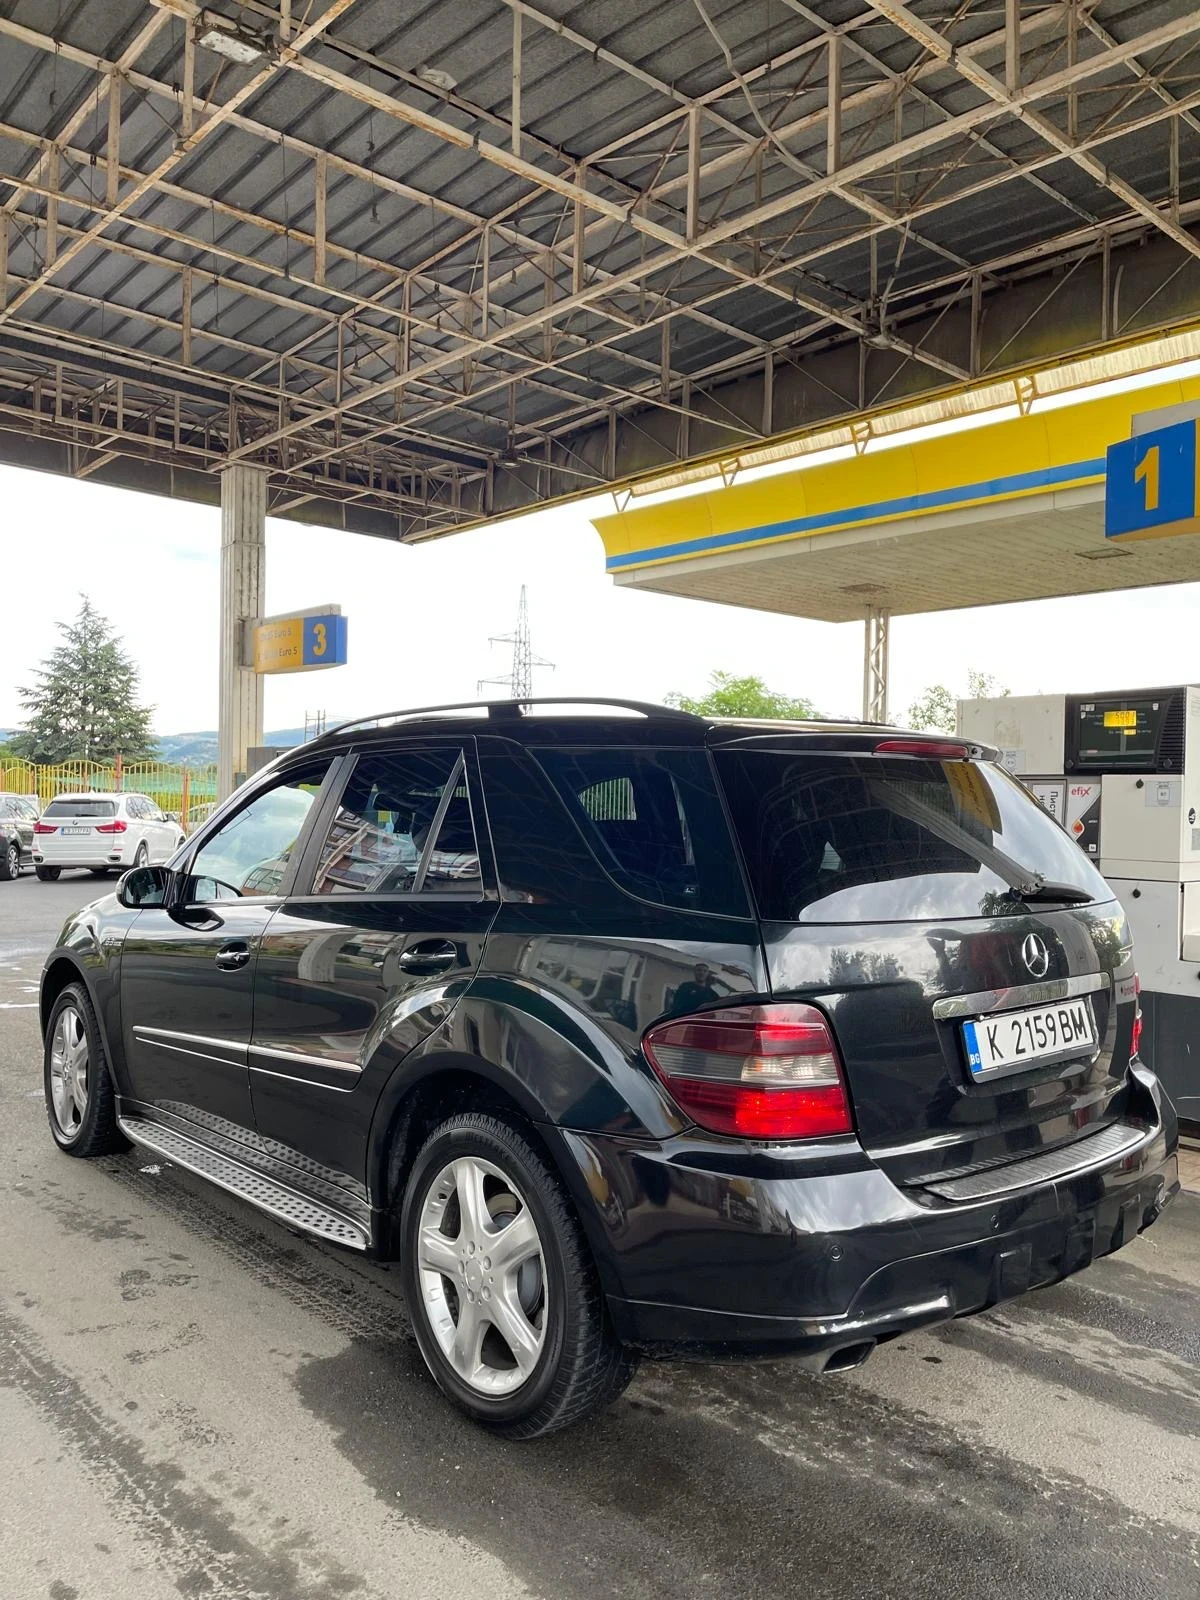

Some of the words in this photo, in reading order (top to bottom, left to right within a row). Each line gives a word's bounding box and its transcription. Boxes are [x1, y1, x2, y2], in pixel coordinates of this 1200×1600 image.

[1134, 446, 1159, 511] 1
[313, 623, 327, 656] 3
[1049, 791, 1058, 816] Пист
[1071, 786, 1091, 797] efix
[986, 1024, 1004, 1060] K
[970, 1052, 980, 1065] BG
